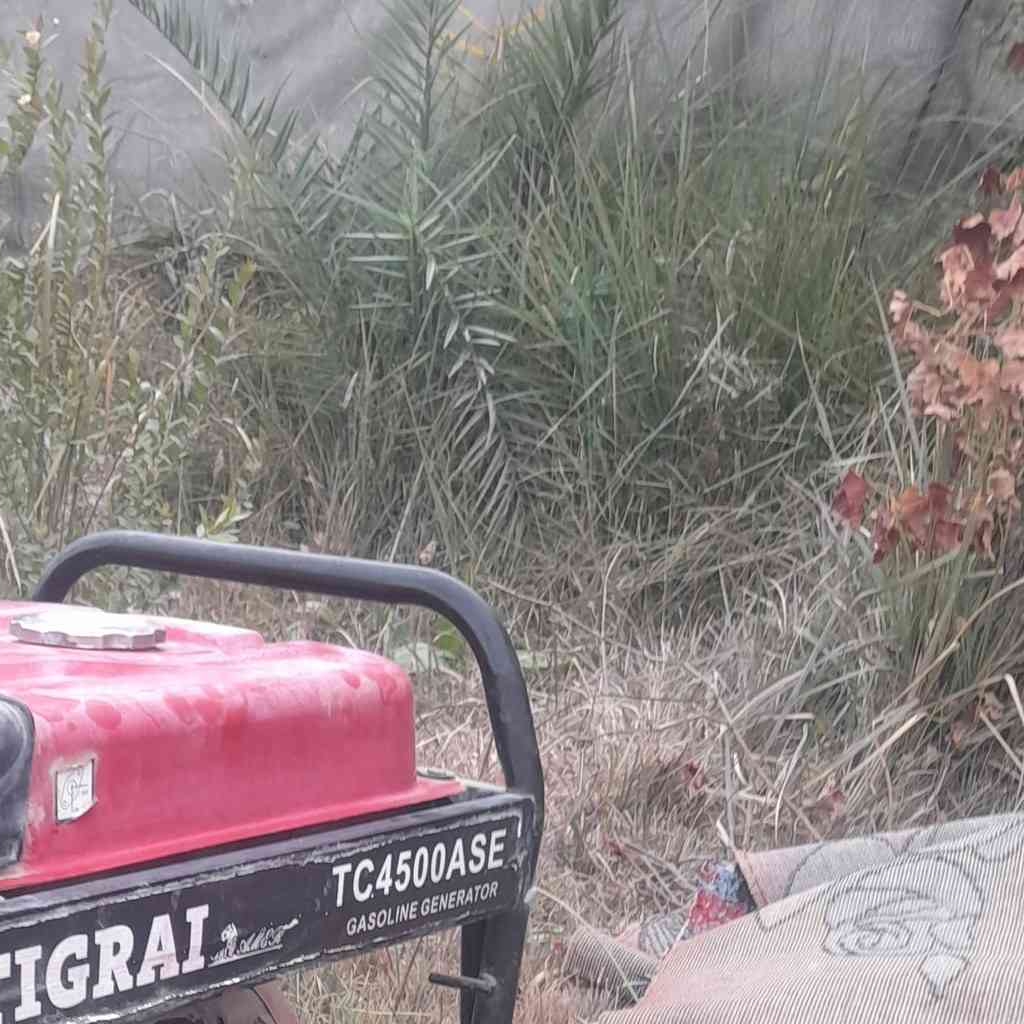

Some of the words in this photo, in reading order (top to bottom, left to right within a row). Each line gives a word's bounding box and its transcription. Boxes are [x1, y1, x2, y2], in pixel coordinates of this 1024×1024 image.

[332, 828, 506, 908] TC4500ASE
[346, 902, 418, 936] GASOLINE
[420, 881, 499, 917] GENERATOR
